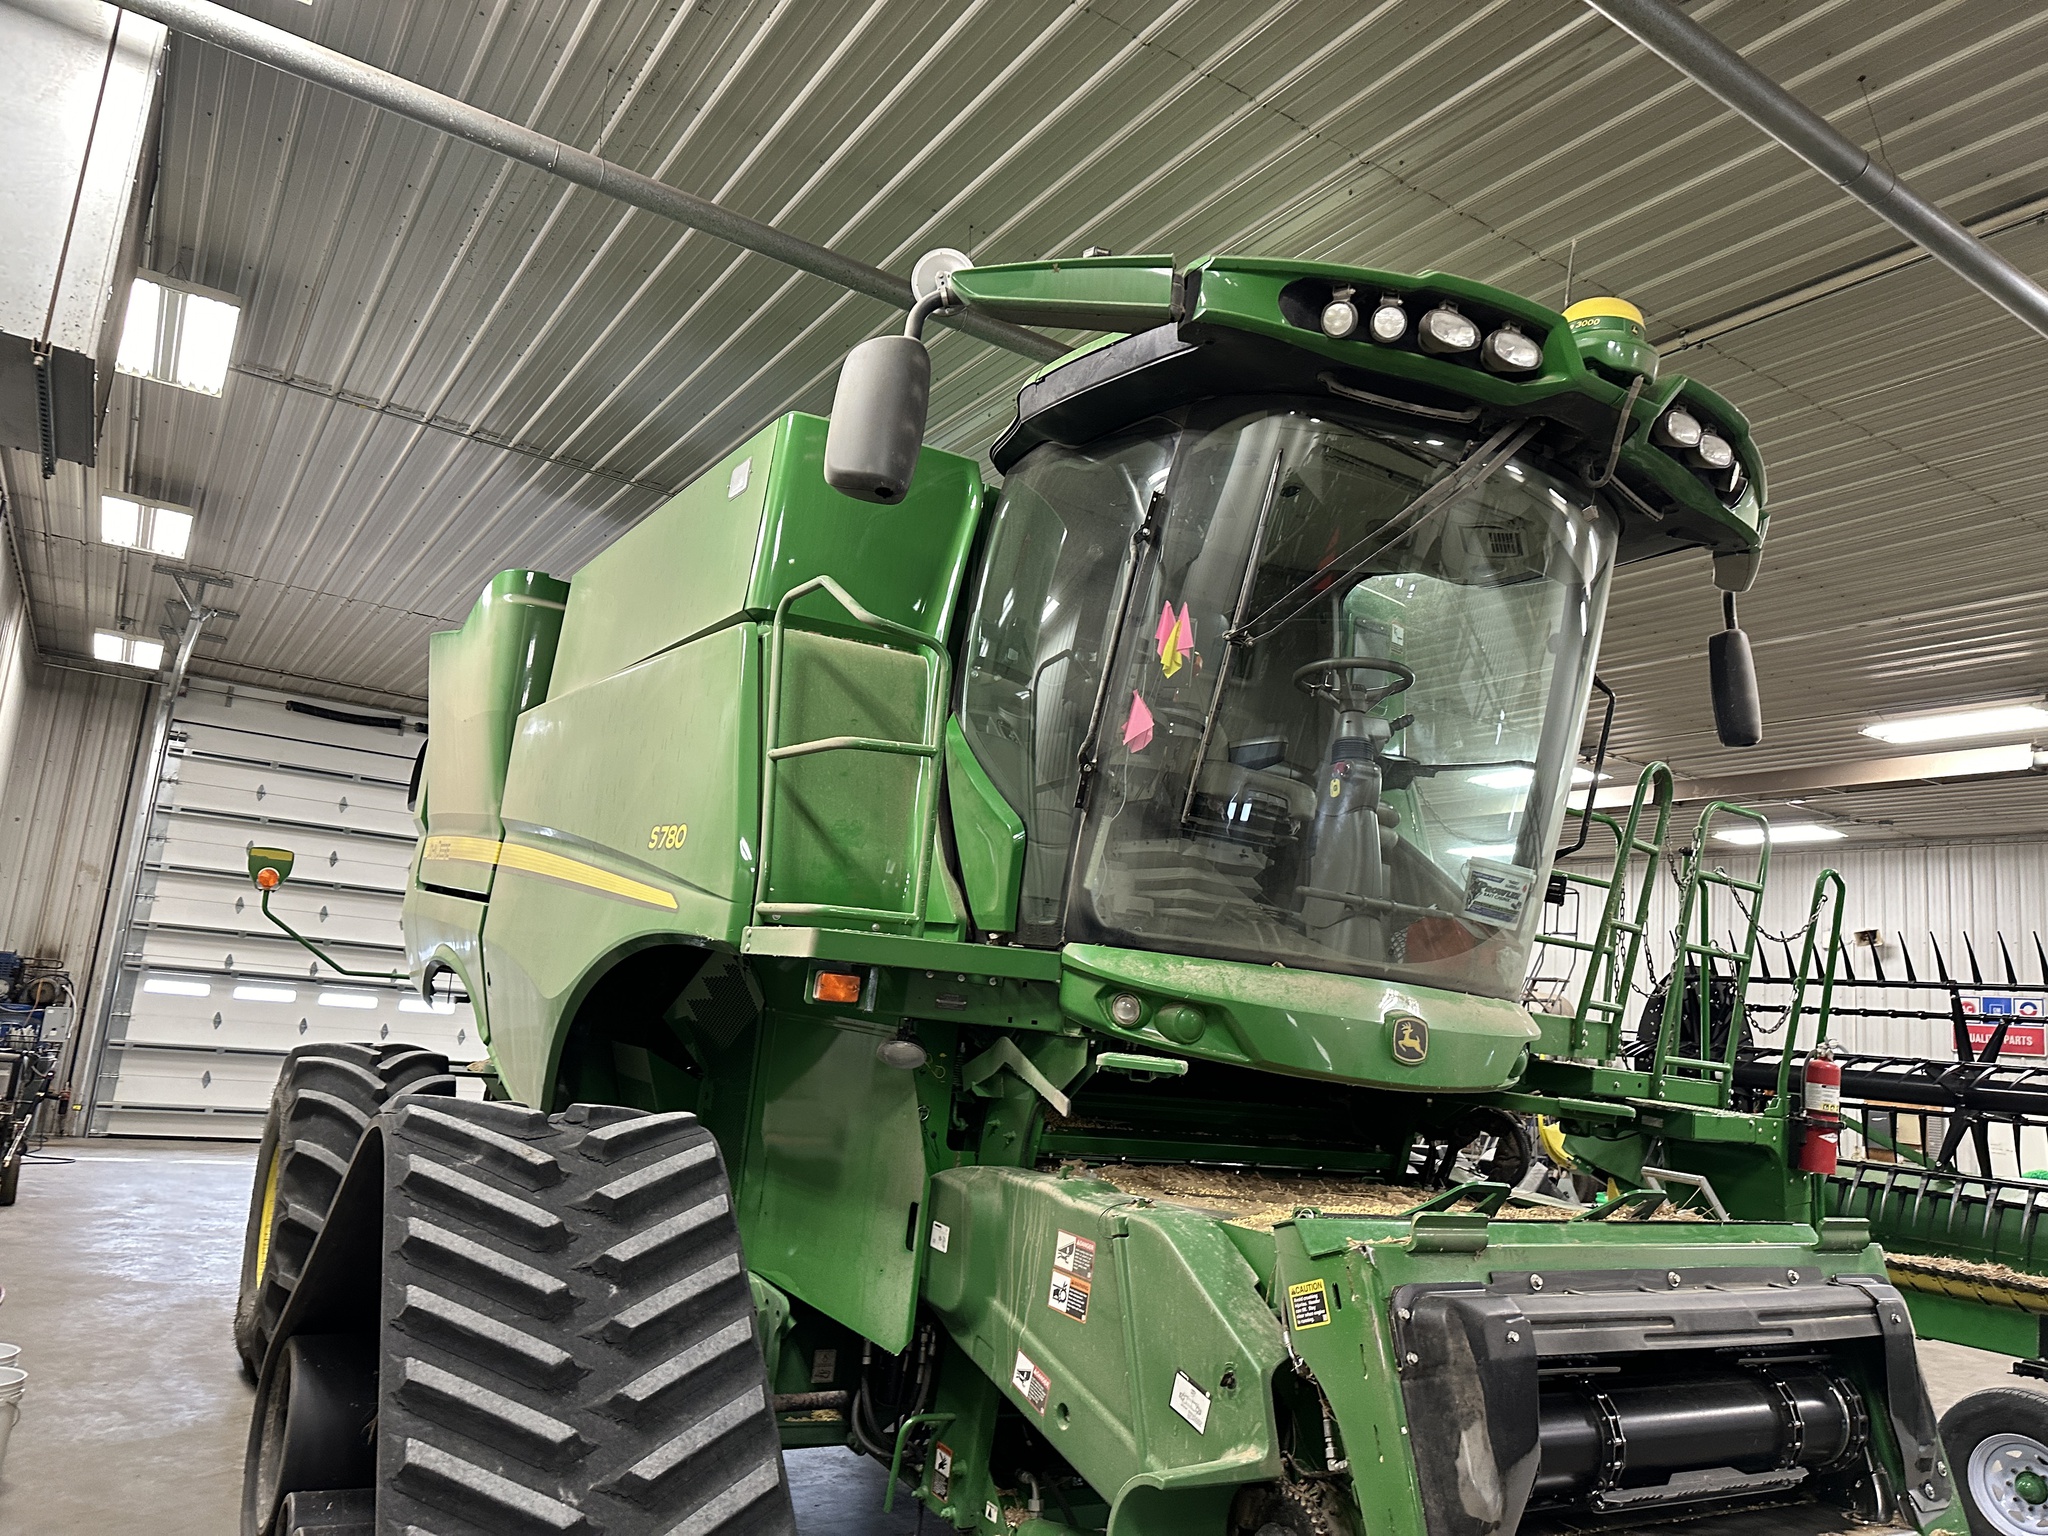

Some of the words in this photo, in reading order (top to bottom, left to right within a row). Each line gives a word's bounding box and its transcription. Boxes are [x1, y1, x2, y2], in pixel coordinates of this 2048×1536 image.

[1576, 318, 1600, 328] 3000
[648, 823, 688, 850] S780
[1970, 1033, 1992, 1044] UALI
[2003, 1035, 2033, 1046] PARTS
[1295, 1281, 1323, 1295] CAUTION
